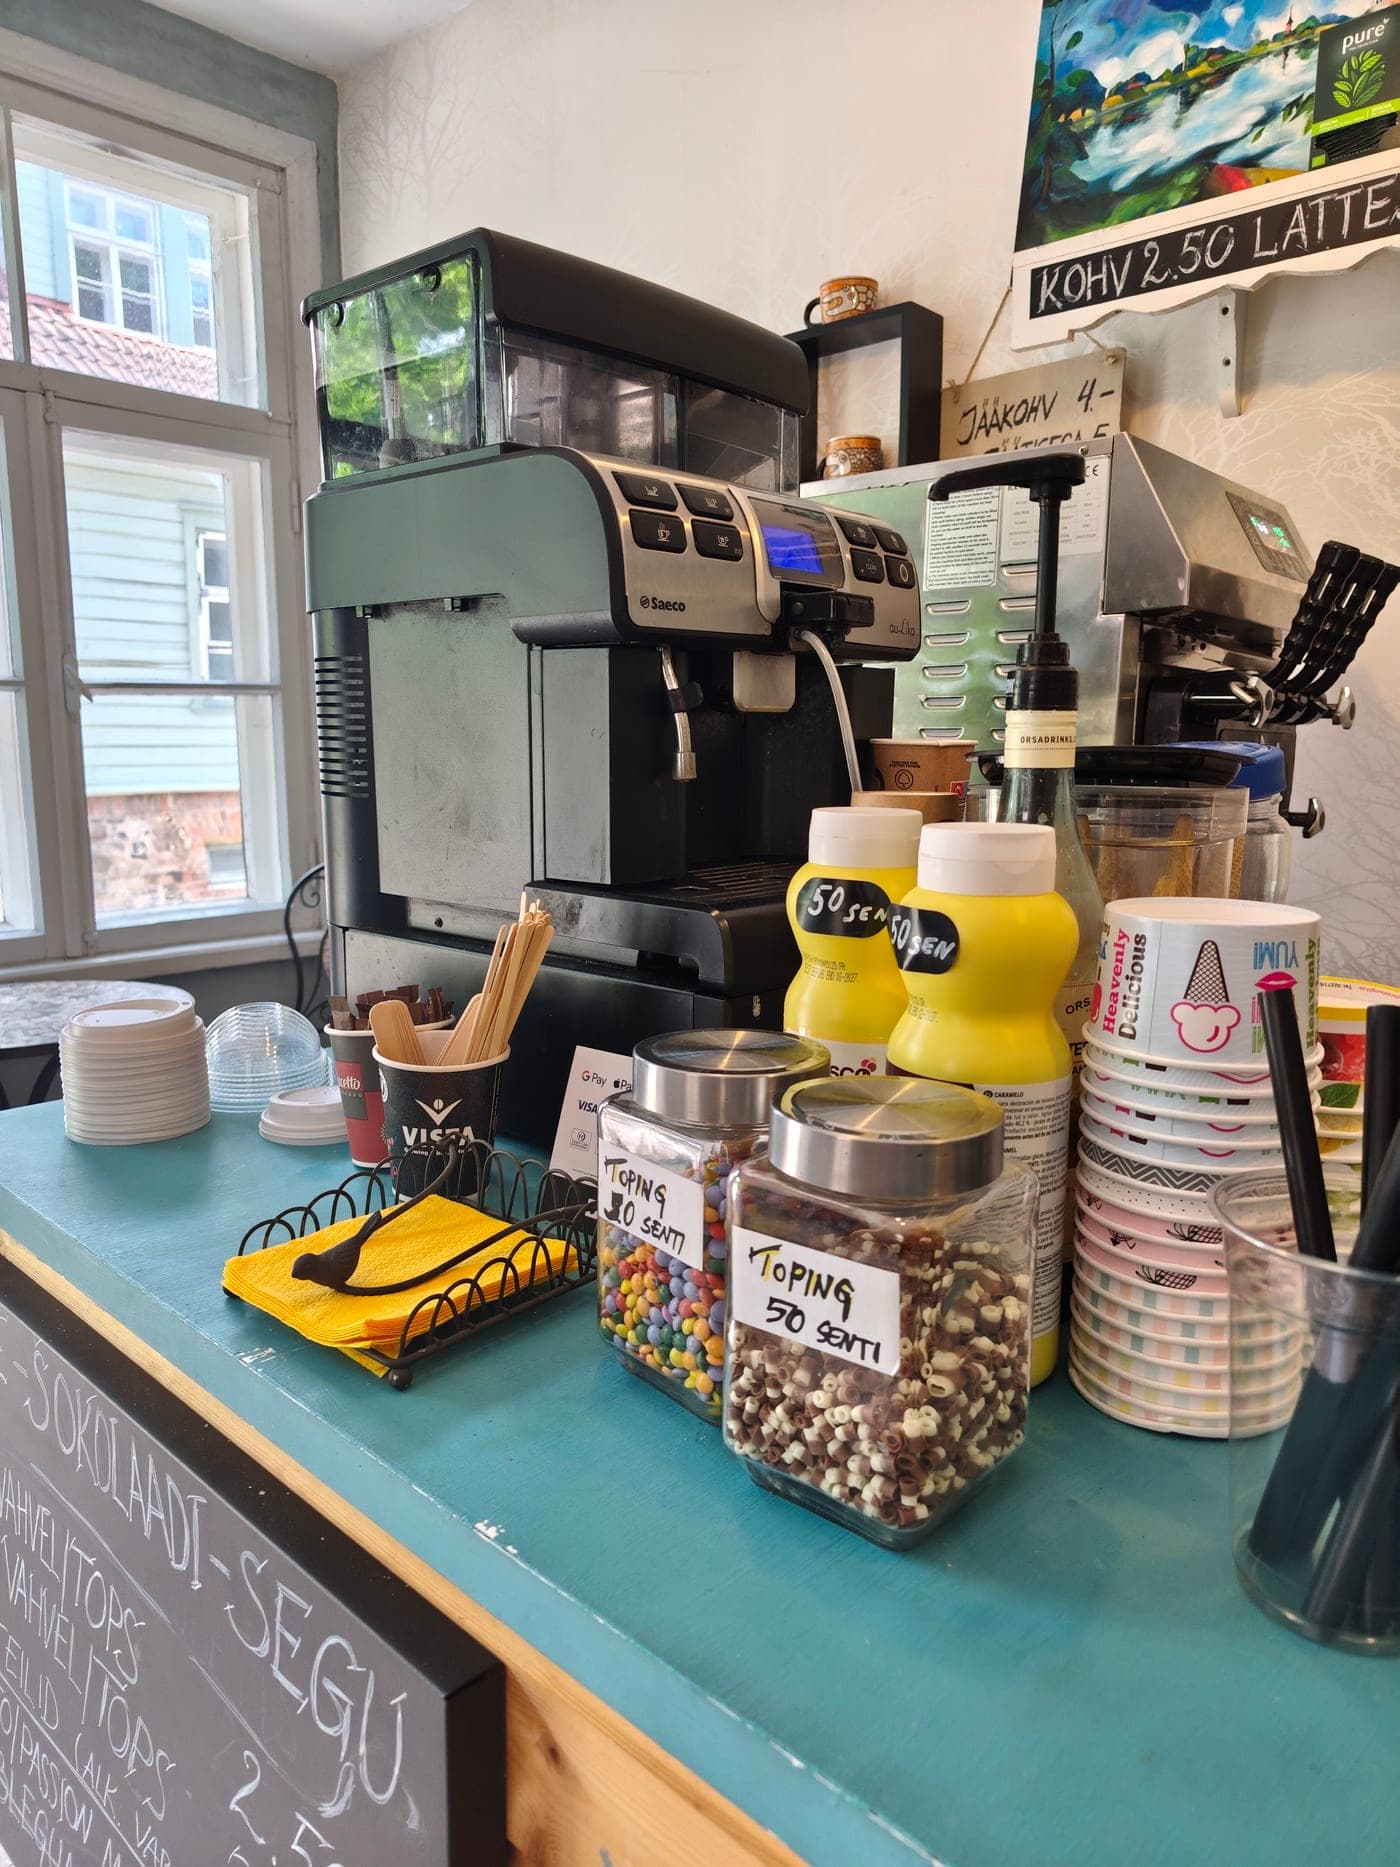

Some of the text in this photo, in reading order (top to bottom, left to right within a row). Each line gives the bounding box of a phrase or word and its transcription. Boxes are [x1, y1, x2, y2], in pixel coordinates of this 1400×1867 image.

[1341, 23, 1386, 55] pure
[1037, 250, 1133, 314] KOHV
[1140, 224, 1235, 288] 2.50
[956, 391, 1059, 445] JÄÄKOHV
[651, 596, 686, 612] Saeco
[807, 884, 845, 916] 50
[890, 914, 956, 960] 50 SEN
[1103, 927, 1130, 1034] Heavenly
[1118, 933, 1147, 1040] Delicious
[591, 1072, 607, 1088] Pay
[578, 1099, 598, 1114] VISA
[604, 1155, 668, 1219] TOPING
[640, 1216, 686, 1255] SENTI
[748, 1244, 855, 1323] TOPING
[765, 1296, 881, 1364] 50 SENTI
